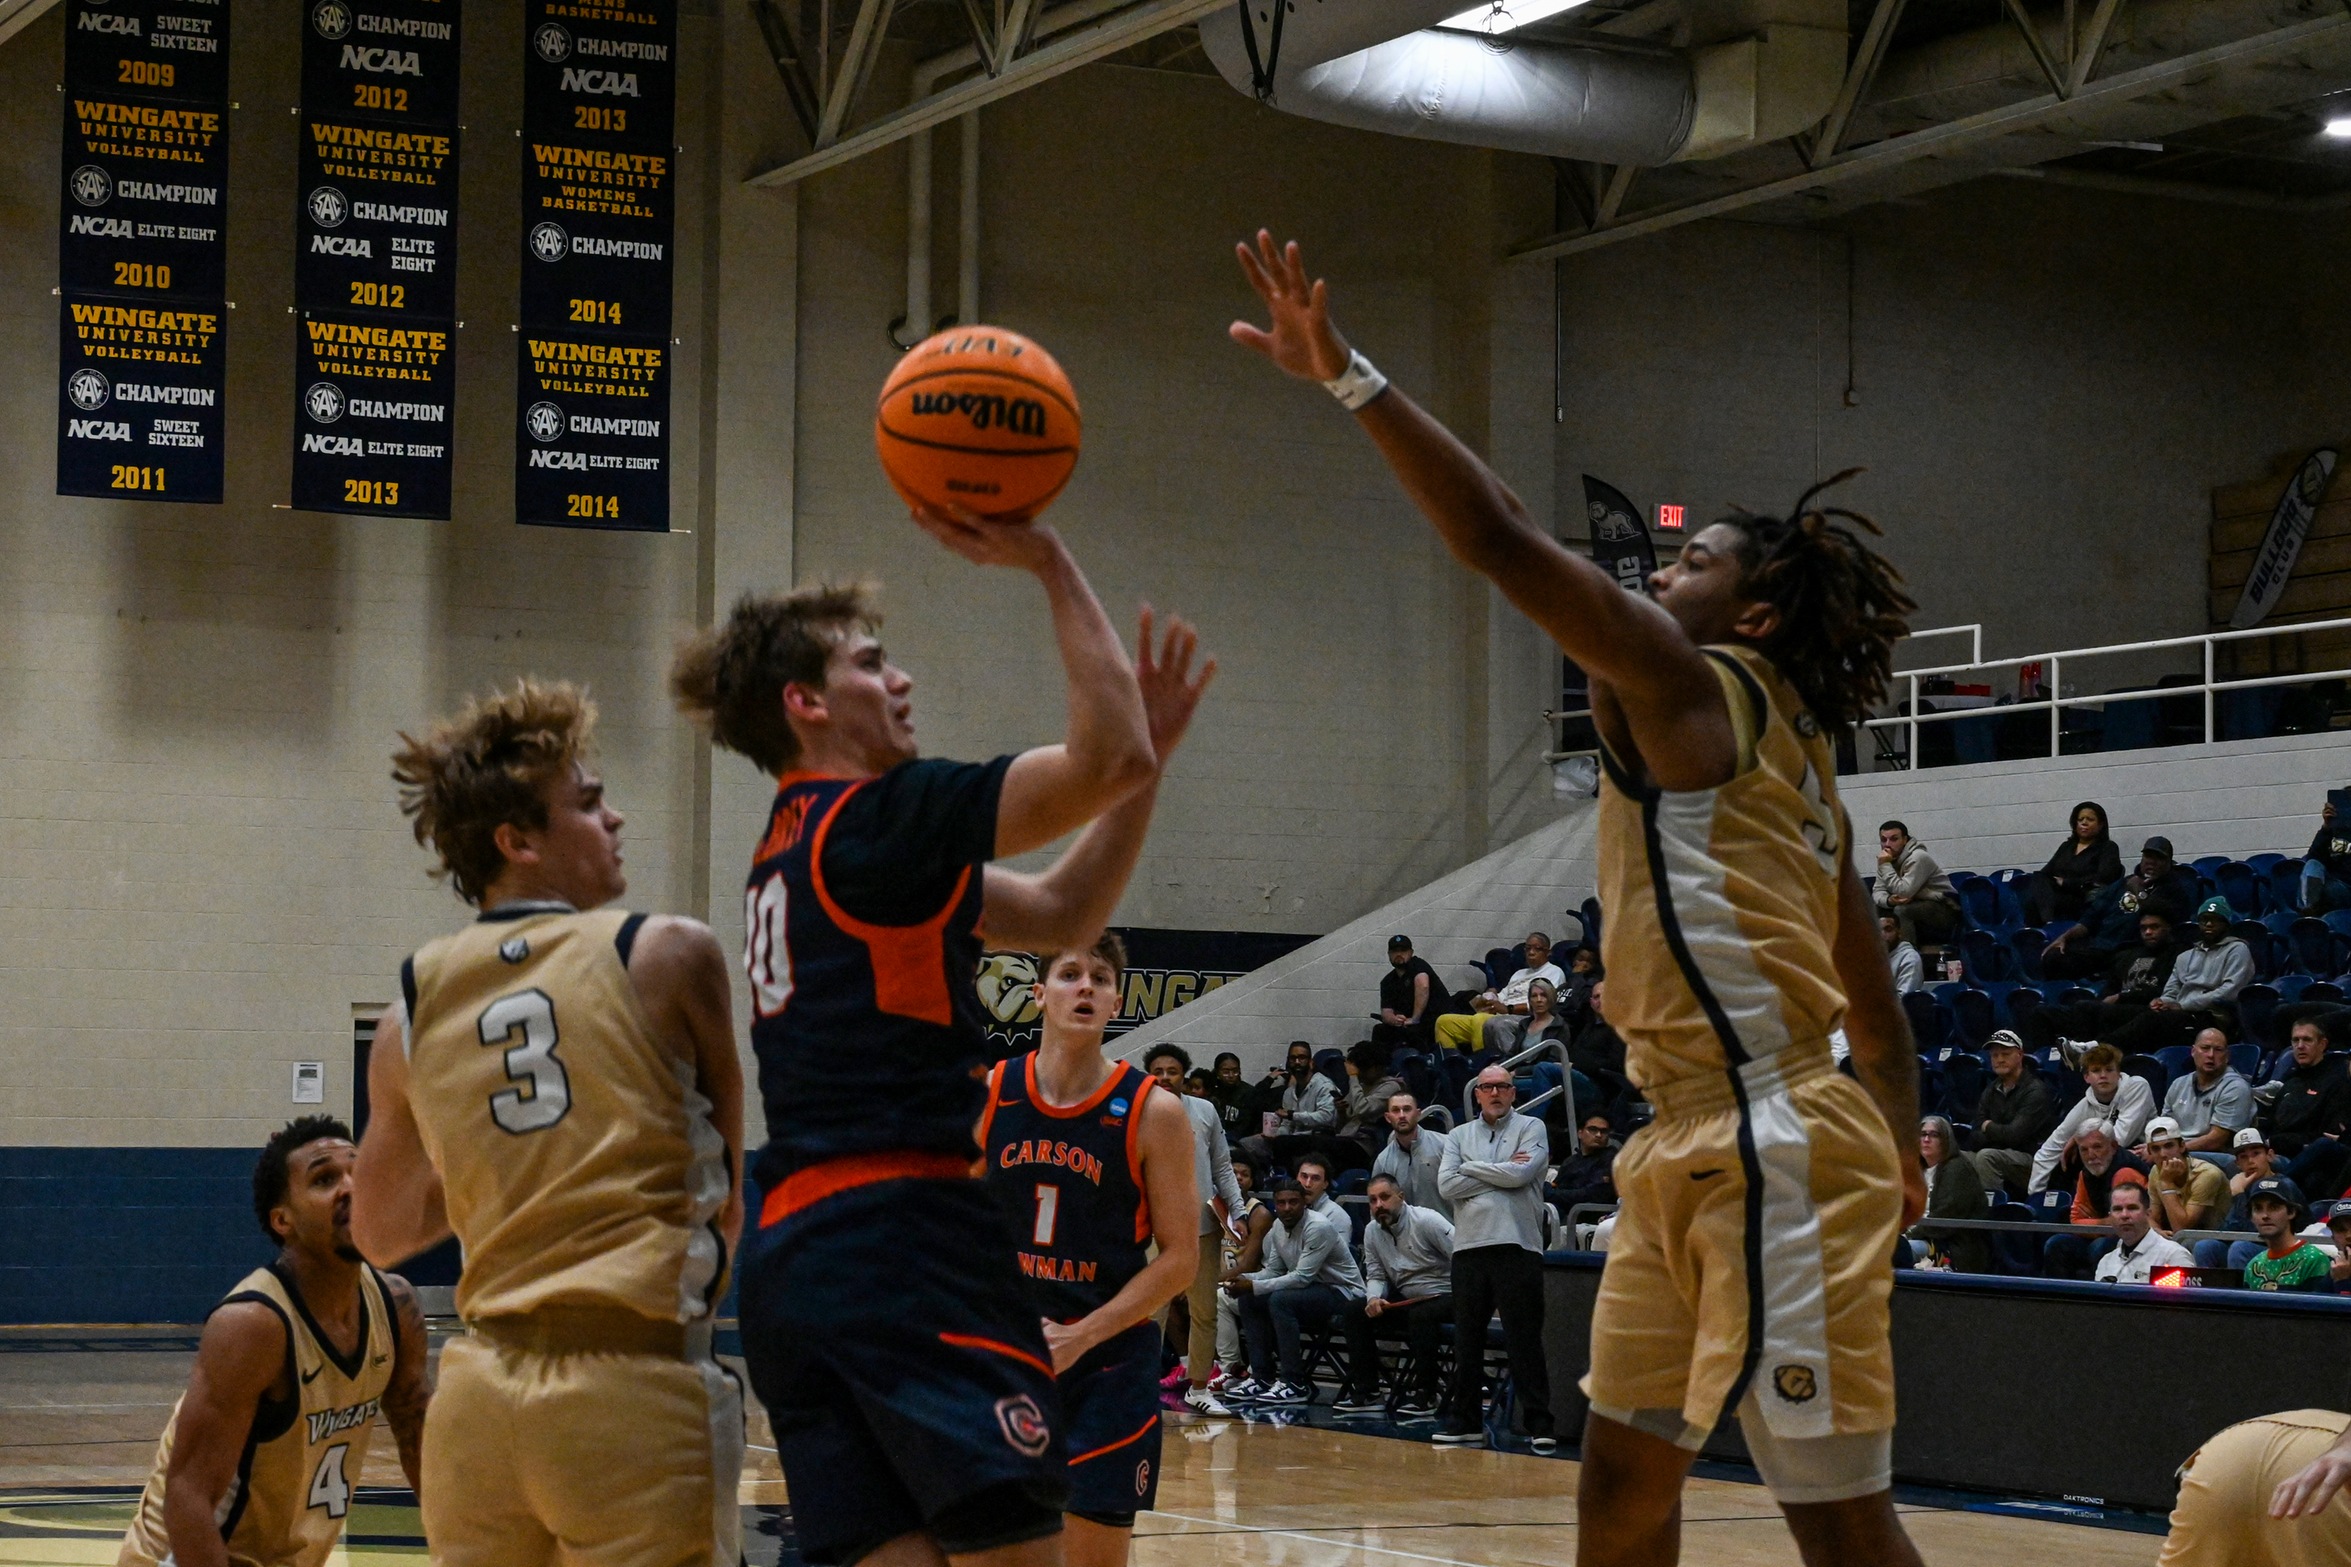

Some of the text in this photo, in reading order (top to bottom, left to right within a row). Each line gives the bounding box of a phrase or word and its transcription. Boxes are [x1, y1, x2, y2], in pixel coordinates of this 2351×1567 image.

[77, 11, 141, 36] NCAA
[157, 15, 212, 34] SWEET
[546, 4, 657, 25] BASKETBALL
[357, 14, 452, 41] CHAMPION
[151, 33, 217, 53] SIXTEEN
[577, 37, 668, 62] CHAMPION
[339, 44, 421, 76] NCAA
[118, 59, 175, 87] 2009
[560, 67, 639, 97] NCAA
[354, 84, 408, 112] 2012
[74, 100, 219, 132] WINGATE
[574, 105, 626, 132] 2013
[81, 122, 212, 147] UNIVERSITY
[311, 123, 450, 155] WINGATE
[86, 141, 204, 163] VOLLEYBALL
[318, 144, 443, 169] UNIVERSITY
[532, 144, 666, 175] WINGATE
[323, 163, 436, 186] VOLLEYBALL
[539, 164, 660, 189] UNIVERSITY
[118, 180, 217, 205] CHAMPION
[561, 185, 636, 203] WOMENS
[314, 193, 341, 221] SAC
[353, 201, 448, 227] CHAMPION
[542, 196, 654, 218] BASKETBALL
[69, 215, 216, 242] NCAA ELITE EIGHT
[310, 234, 372, 258] NCAA
[391, 237, 435, 255] ELITE
[536, 228, 562, 256] SAC
[572, 236, 663, 261] CHAMPION
[114, 262, 171, 289] 2010
[391, 255, 436, 273] EIGHT
[350, 281, 405, 308] 2012
[71, 303, 217, 334] WINGATE
[569, 299, 621, 325] 2014
[78, 325, 210, 348] UNIVERSITY
[306, 321, 446, 351] WINGATE
[83, 345, 202, 365] VOLLEYBALL
[313, 342, 439, 365] UNIVERSITY
[528, 339, 662, 367] WINGATE
[318, 361, 432, 381] VOLLEYBALL
[534, 360, 655, 381] UNIVERSITY
[75, 374, 102, 404] SAC
[115, 383, 215, 406] CHAMPION
[540, 379, 649, 398] VOLLEYBALL
[311, 388, 338, 417] SAC
[349, 399, 444, 422] CHAMPION
[912, 392, 1046, 437] Wilson
[67, 418, 131, 442] NCAA
[154, 419, 199, 434] SWEET
[532, 407, 558, 436] SAC
[570, 415, 660, 437] CHAMPION
[148, 432, 204, 447] SIXTEEN
[301, 433, 444, 458] NCAA ELITE EIGHT
[529, 449, 659, 471] NCAA ELITE EIGHT
[111, 464, 165, 491] 2011
[344, 479, 399, 505] 2013
[567, 494, 619, 518] 2014
[1660, 504, 1684, 528] EXIT
[477, 987, 571, 1136] 3
[1000, 1138, 1104, 1187] CARSON
[1032, 1181, 1060, 1247] 1
[307, 1441, 350, 1520] 4
[2063, 1493, 2105, 1506] DAKTRONICS
